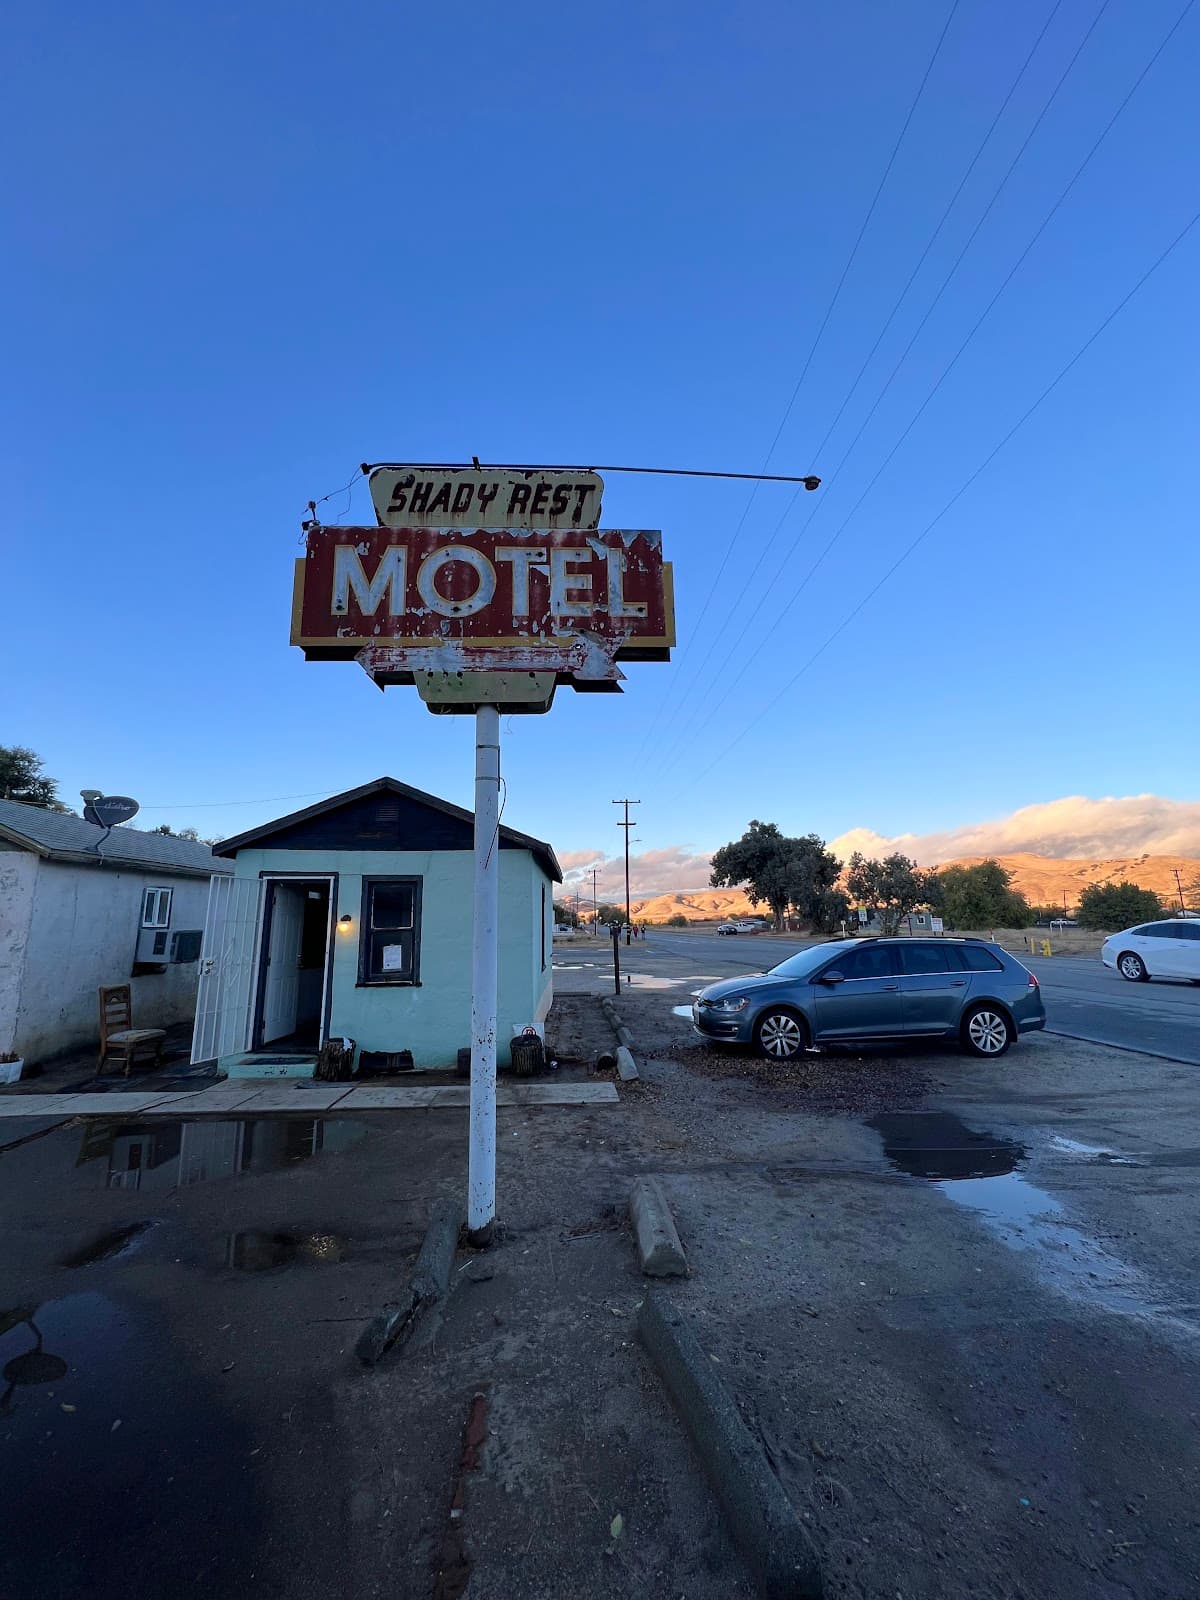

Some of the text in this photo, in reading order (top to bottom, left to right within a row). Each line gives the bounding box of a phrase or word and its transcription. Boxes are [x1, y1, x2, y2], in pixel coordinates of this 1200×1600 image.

[387, 475, 596, 522] SHADY REST
[330, 544, 649, 618] MOTEL
